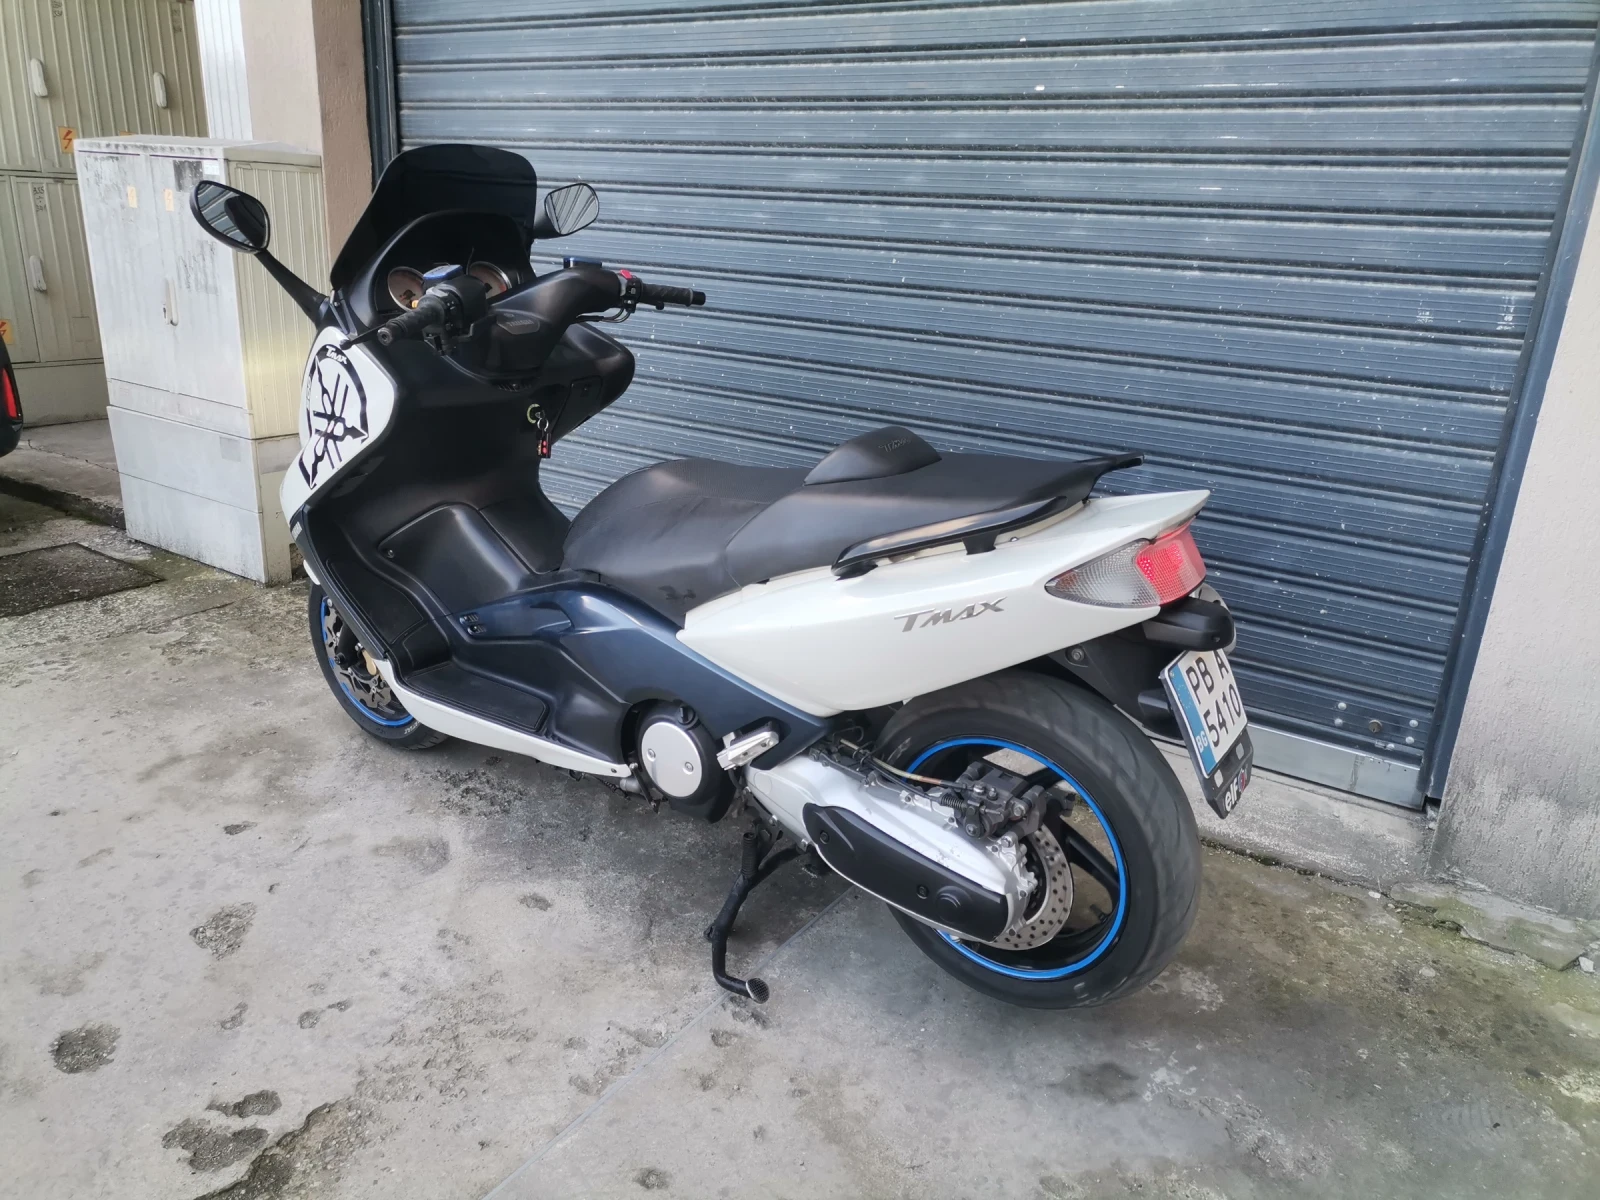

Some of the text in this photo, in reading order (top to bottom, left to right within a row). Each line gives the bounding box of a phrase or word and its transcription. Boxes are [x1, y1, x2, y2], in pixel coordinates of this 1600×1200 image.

[894, 596, 1008, 632] TMAX
[1186, 650, 1228, 704] PB A
[1203, 684, 1241, 747] 5410
[1195, 731, 1208, 753] BG
